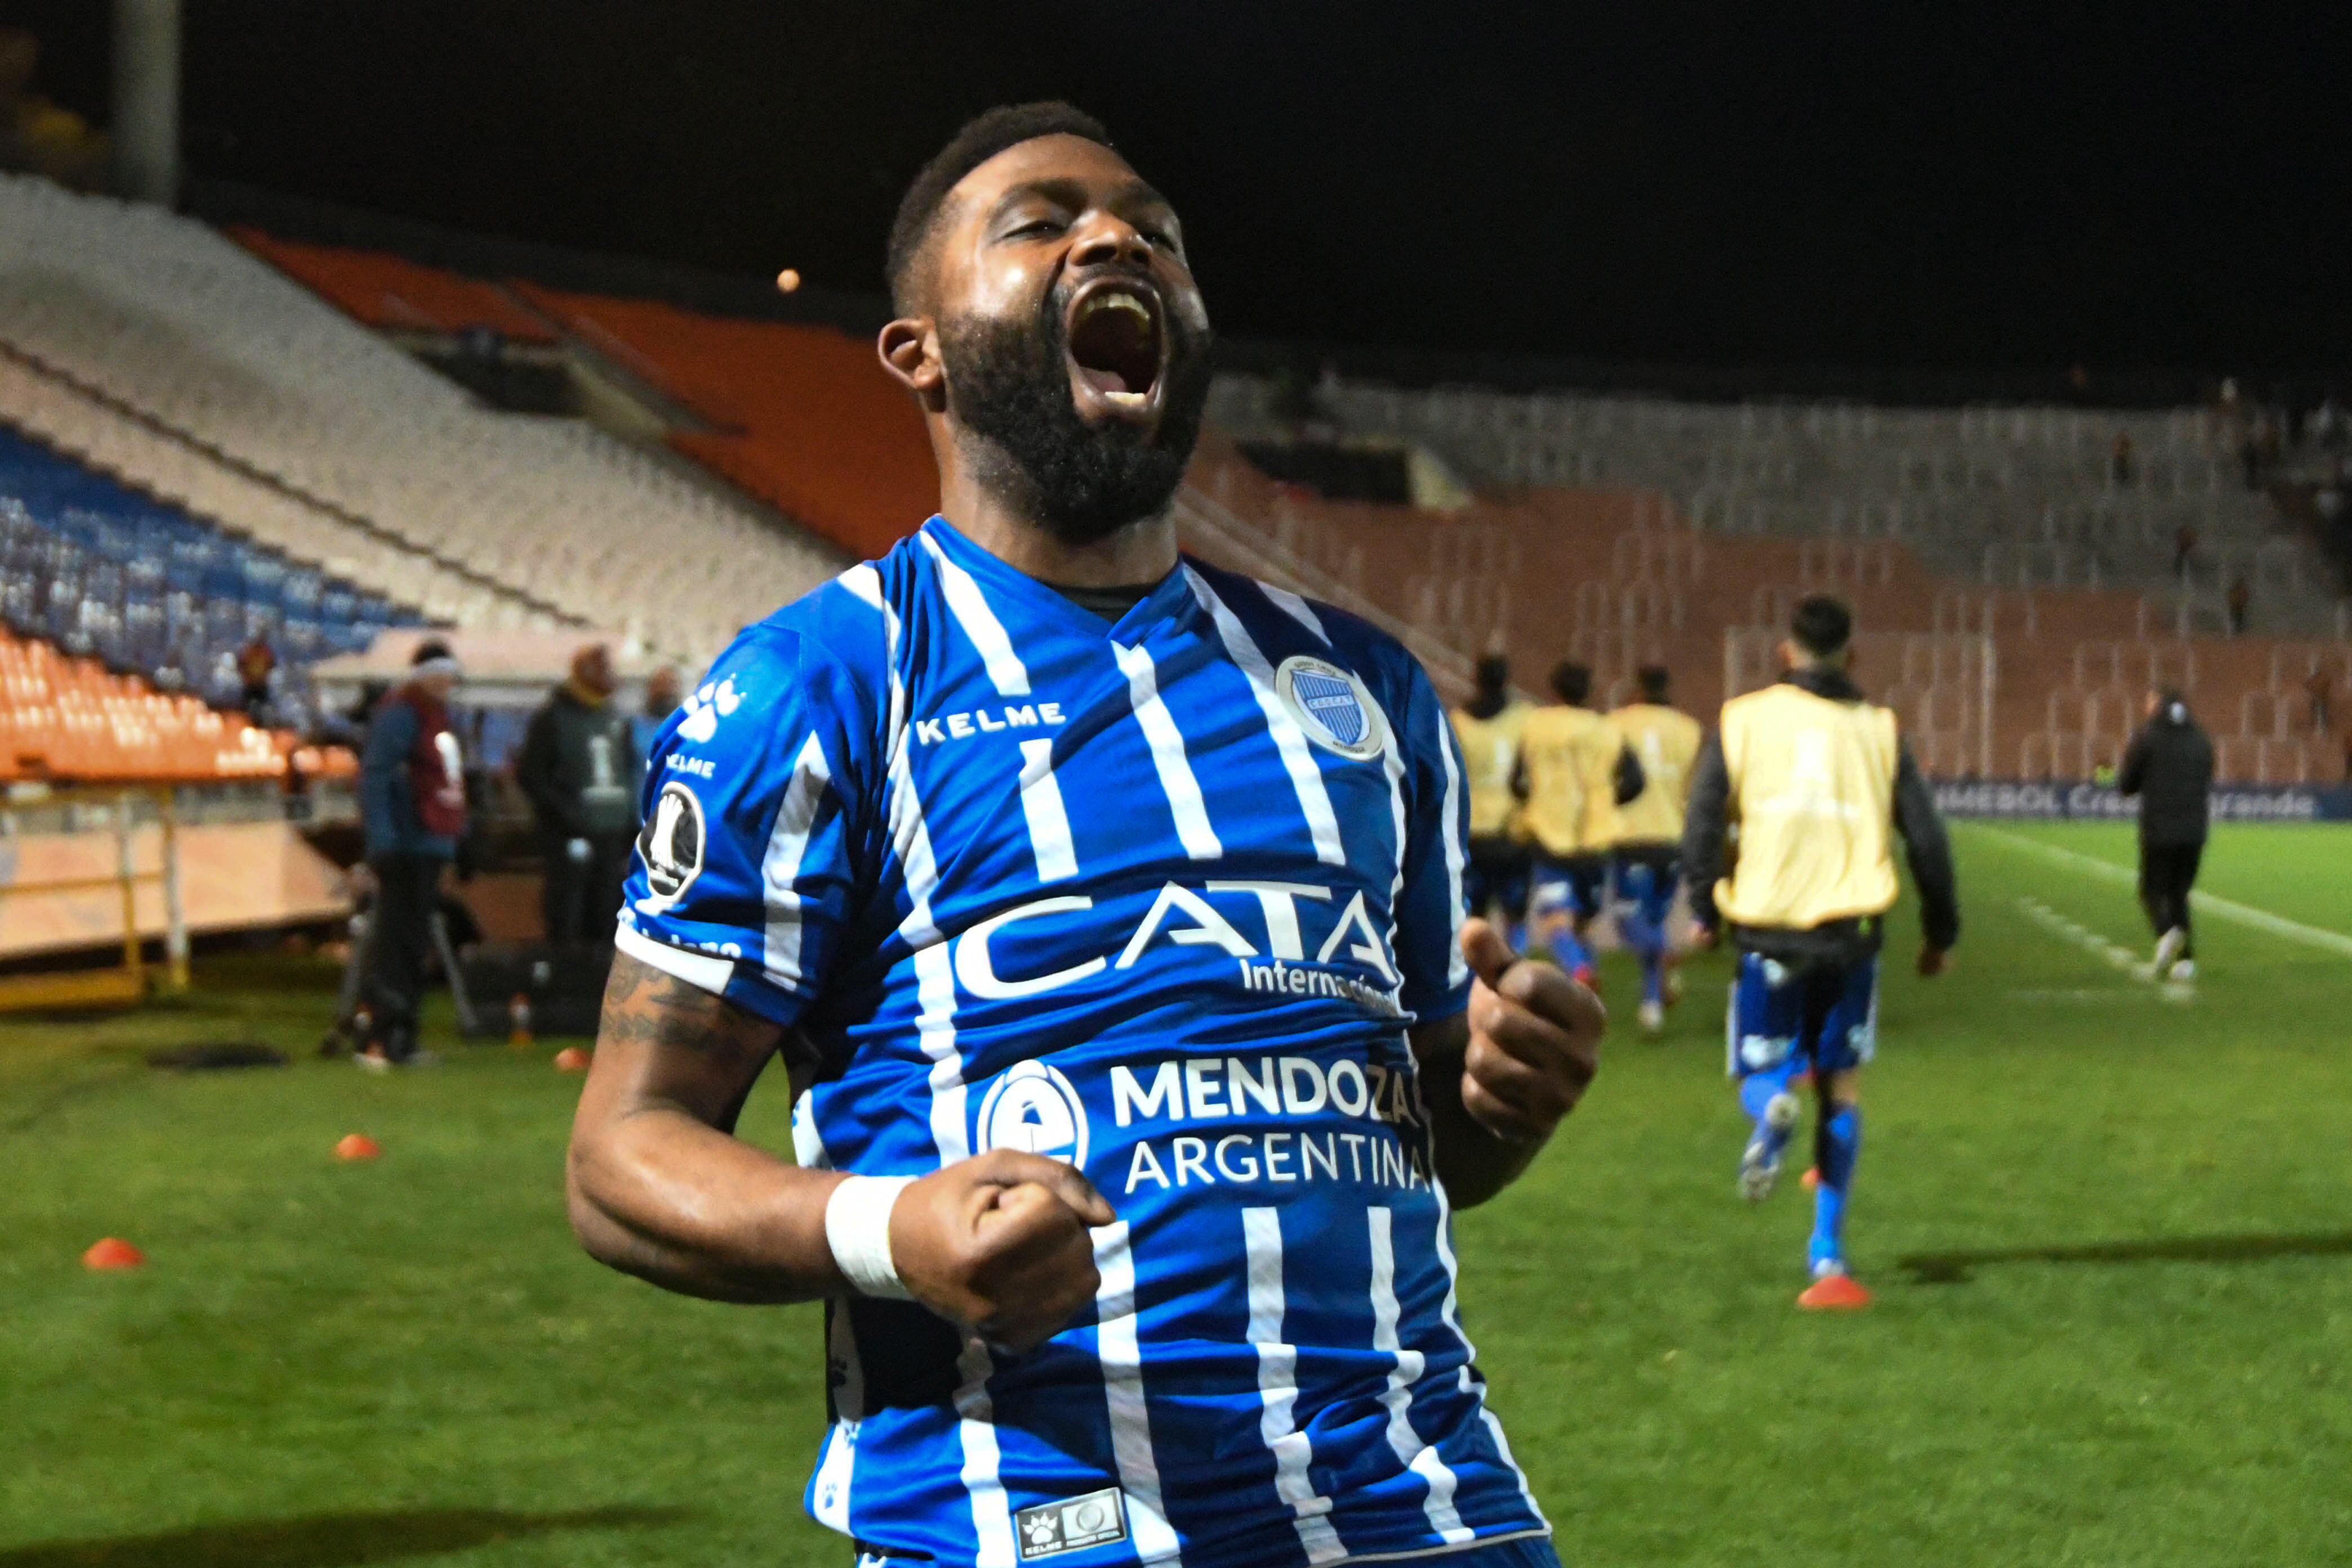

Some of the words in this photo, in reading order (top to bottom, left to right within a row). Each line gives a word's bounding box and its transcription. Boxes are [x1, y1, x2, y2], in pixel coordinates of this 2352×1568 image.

[916, 702, 1066, 746] KELME
[955, 880, 1398, 1000] CATA
[1111, 1057, 1420, 1127] MENDOZA
[1124, 1132, 1431, 1194] ARGENTINA
